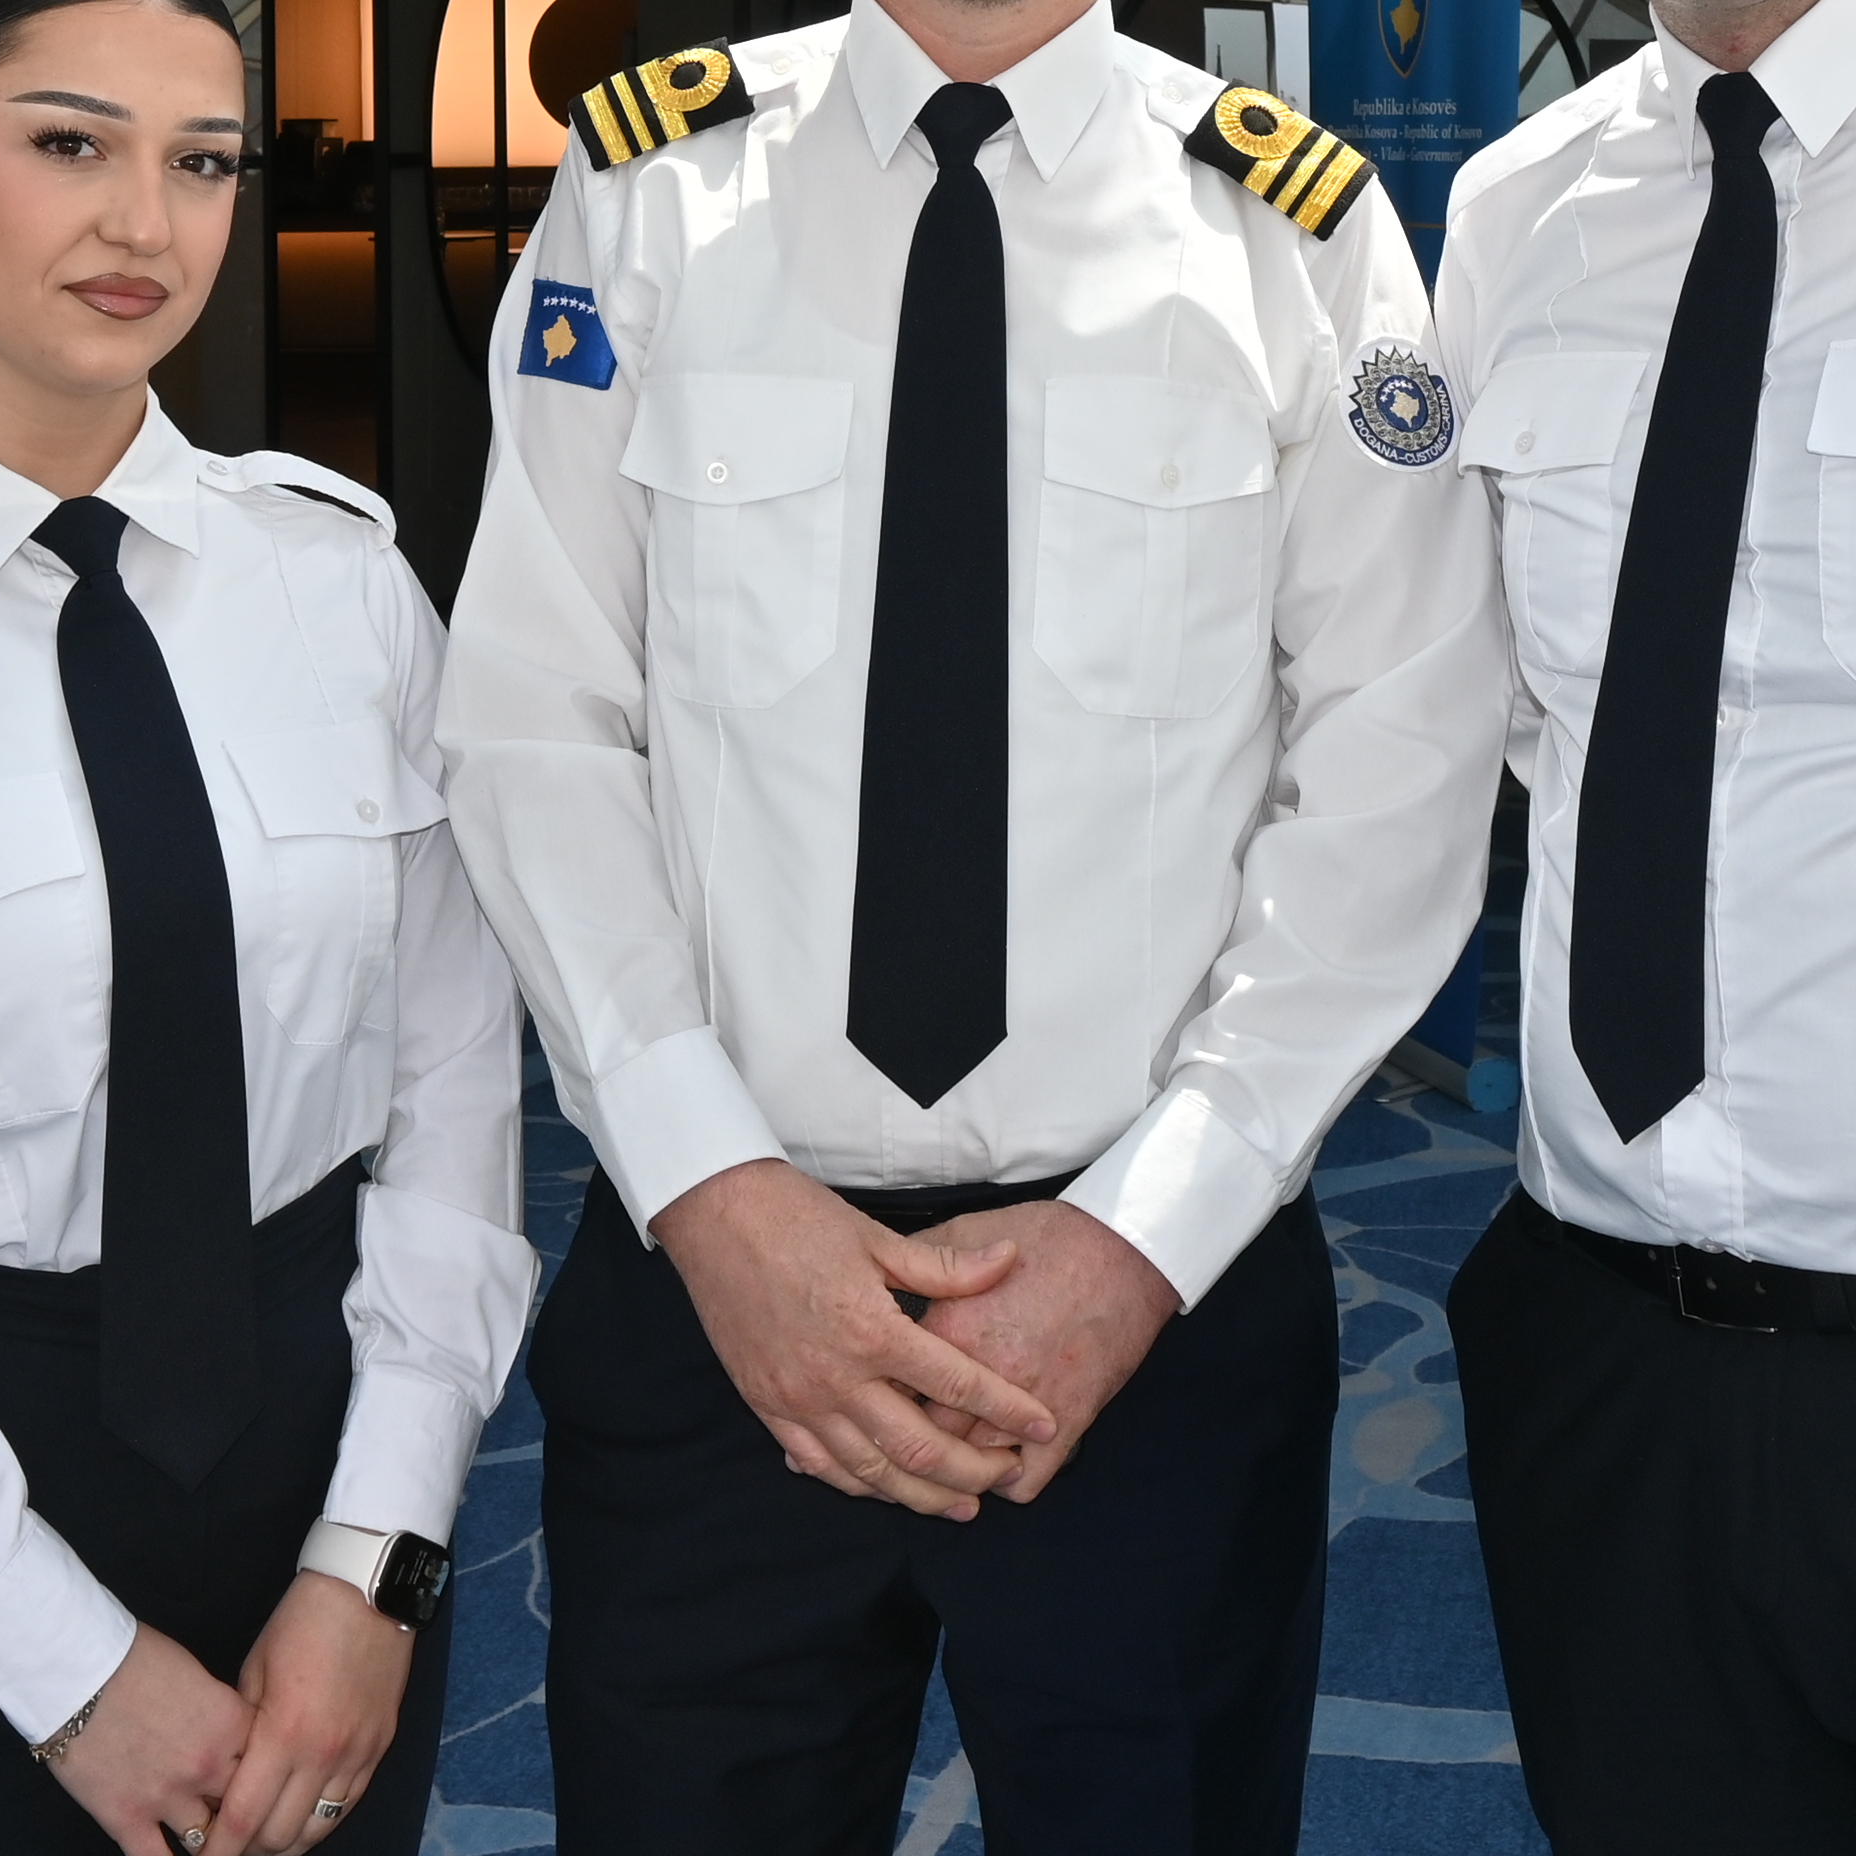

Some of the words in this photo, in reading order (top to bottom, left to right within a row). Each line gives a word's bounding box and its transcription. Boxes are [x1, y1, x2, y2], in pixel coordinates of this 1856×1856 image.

[1353, 98, 1404, 120] Republika
[1405, 103, 1411, 115] e
[1412, 97, 1457, 115] Kosovës
[1364, 124, 1398, 139] Kosova
[1404, 124, 1439, 143] Republic
[1441, 124, 1452, 139] of
[1454, 125, 1483, 139] Kosovo
